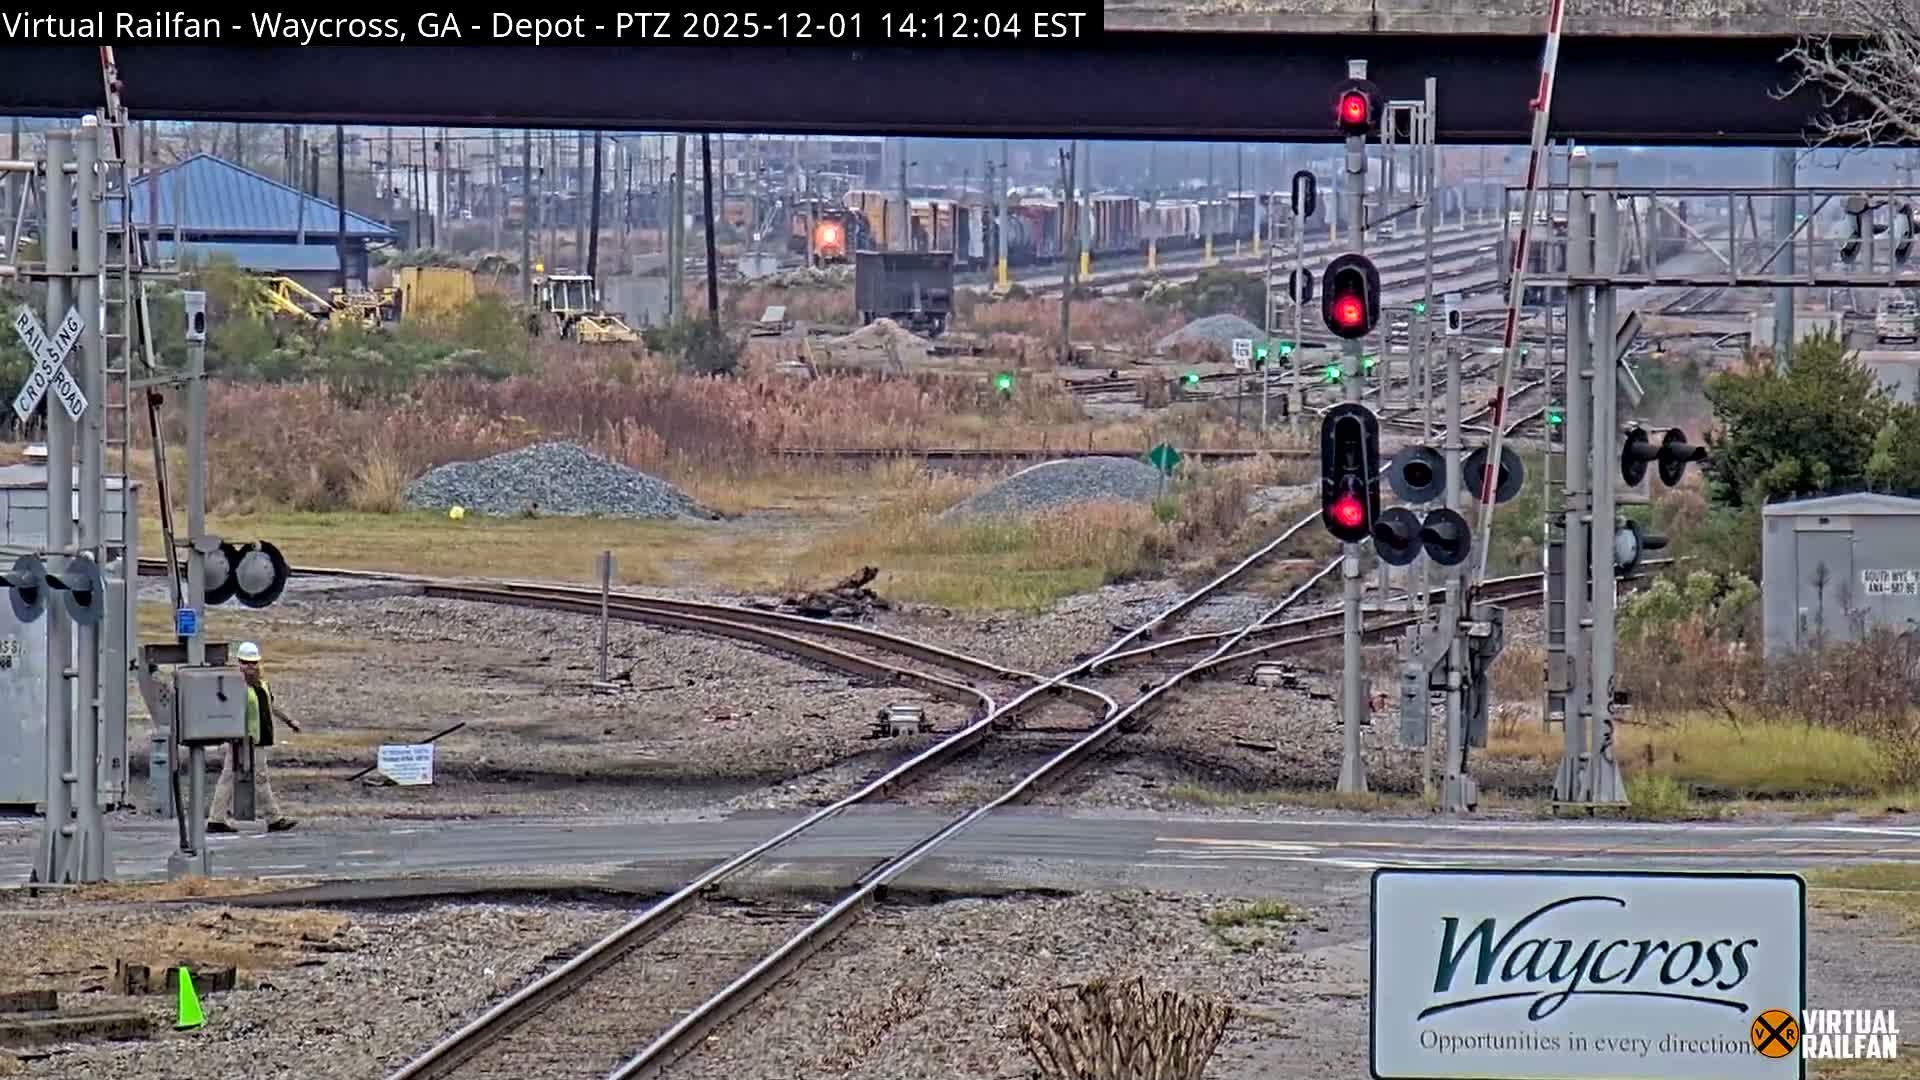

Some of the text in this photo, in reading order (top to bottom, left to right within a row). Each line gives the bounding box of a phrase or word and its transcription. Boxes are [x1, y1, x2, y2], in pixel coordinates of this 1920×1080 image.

[17, 313, 43, 357] RAIL
[19, 317, 79, 412] CROSSING
[54, 371, 82, 415] ROAD
[1433, 896, 1759, 1021] Waycross
[1419, 1030, 1561, 1054] Opportunities
[1569, 1031, 1588, 1052] in
[1595, 1037, 1652, 1058] every
